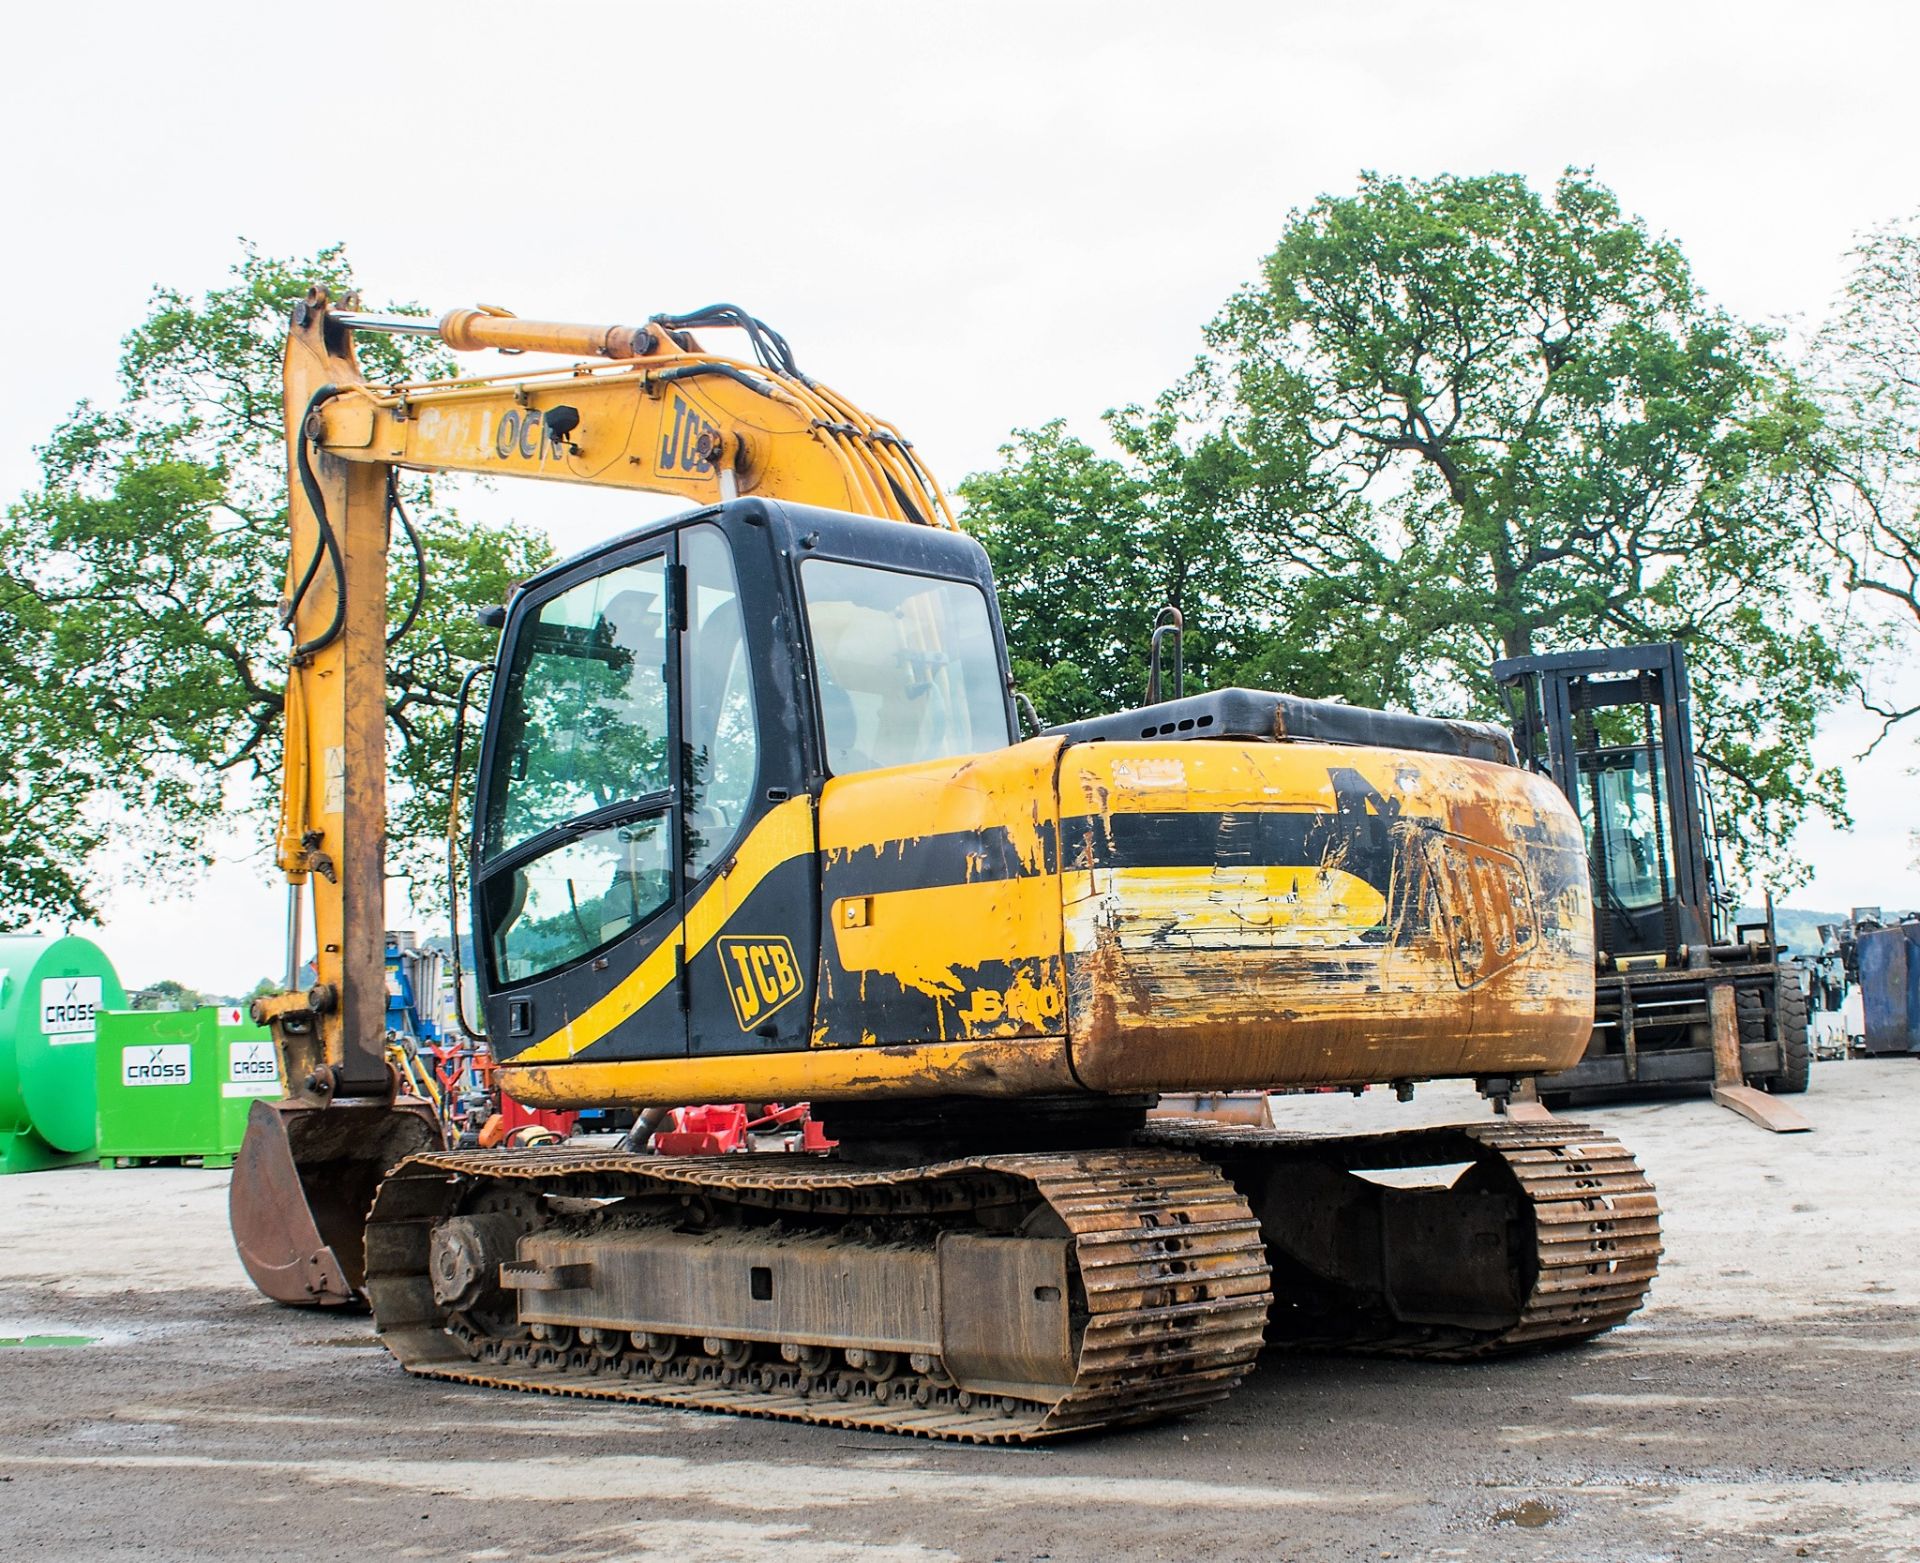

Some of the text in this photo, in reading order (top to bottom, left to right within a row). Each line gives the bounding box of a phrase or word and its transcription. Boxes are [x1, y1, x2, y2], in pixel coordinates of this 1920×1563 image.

[730, 945, 797, 1021] JCB
[46, 1004, 96, 1023] CROSS
[128, 1064, 186, 1078] CROSS
[234, 1061, 274, 1074] CROSS
